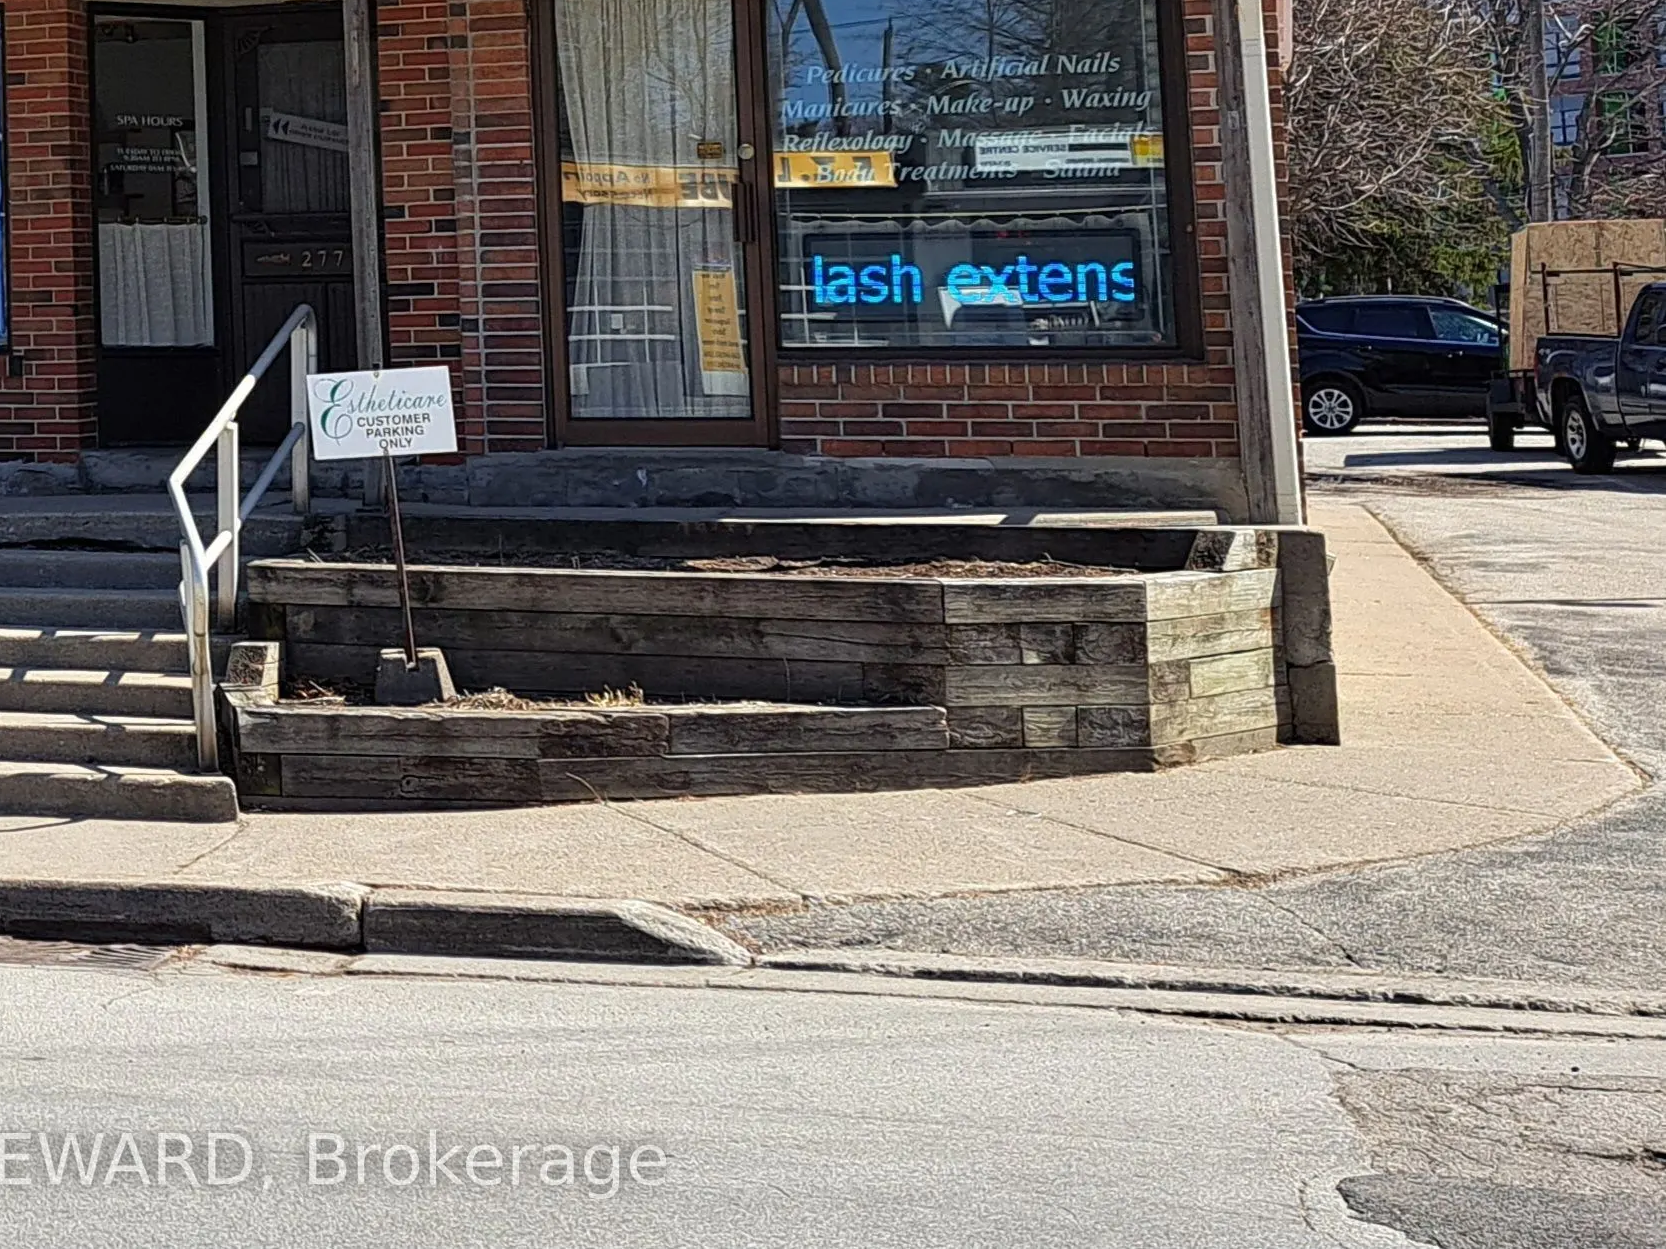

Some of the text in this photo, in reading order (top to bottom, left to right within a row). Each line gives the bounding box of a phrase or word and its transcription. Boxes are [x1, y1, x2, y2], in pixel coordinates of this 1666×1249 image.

[806, 52, 1121, 84] Pedicures Artificial Nails
[781, 86, 1152, 119] Manicures Make-up Waxing
[117, 115, 183, 127] SPA HOURS
[783, 129, 913, 155] Reflexology
[885, 161, 1018, 183] Treatments
[301, 250, 344, 267] 277
[813, 254, 1134, 303] lash extens
[313, 378, 447, 446] Estheticare
[356, 413, 432, 428] CUSTOMER
[365, 426, 425, 438] PARKING
[379, 437, 413, 450] ONLY
